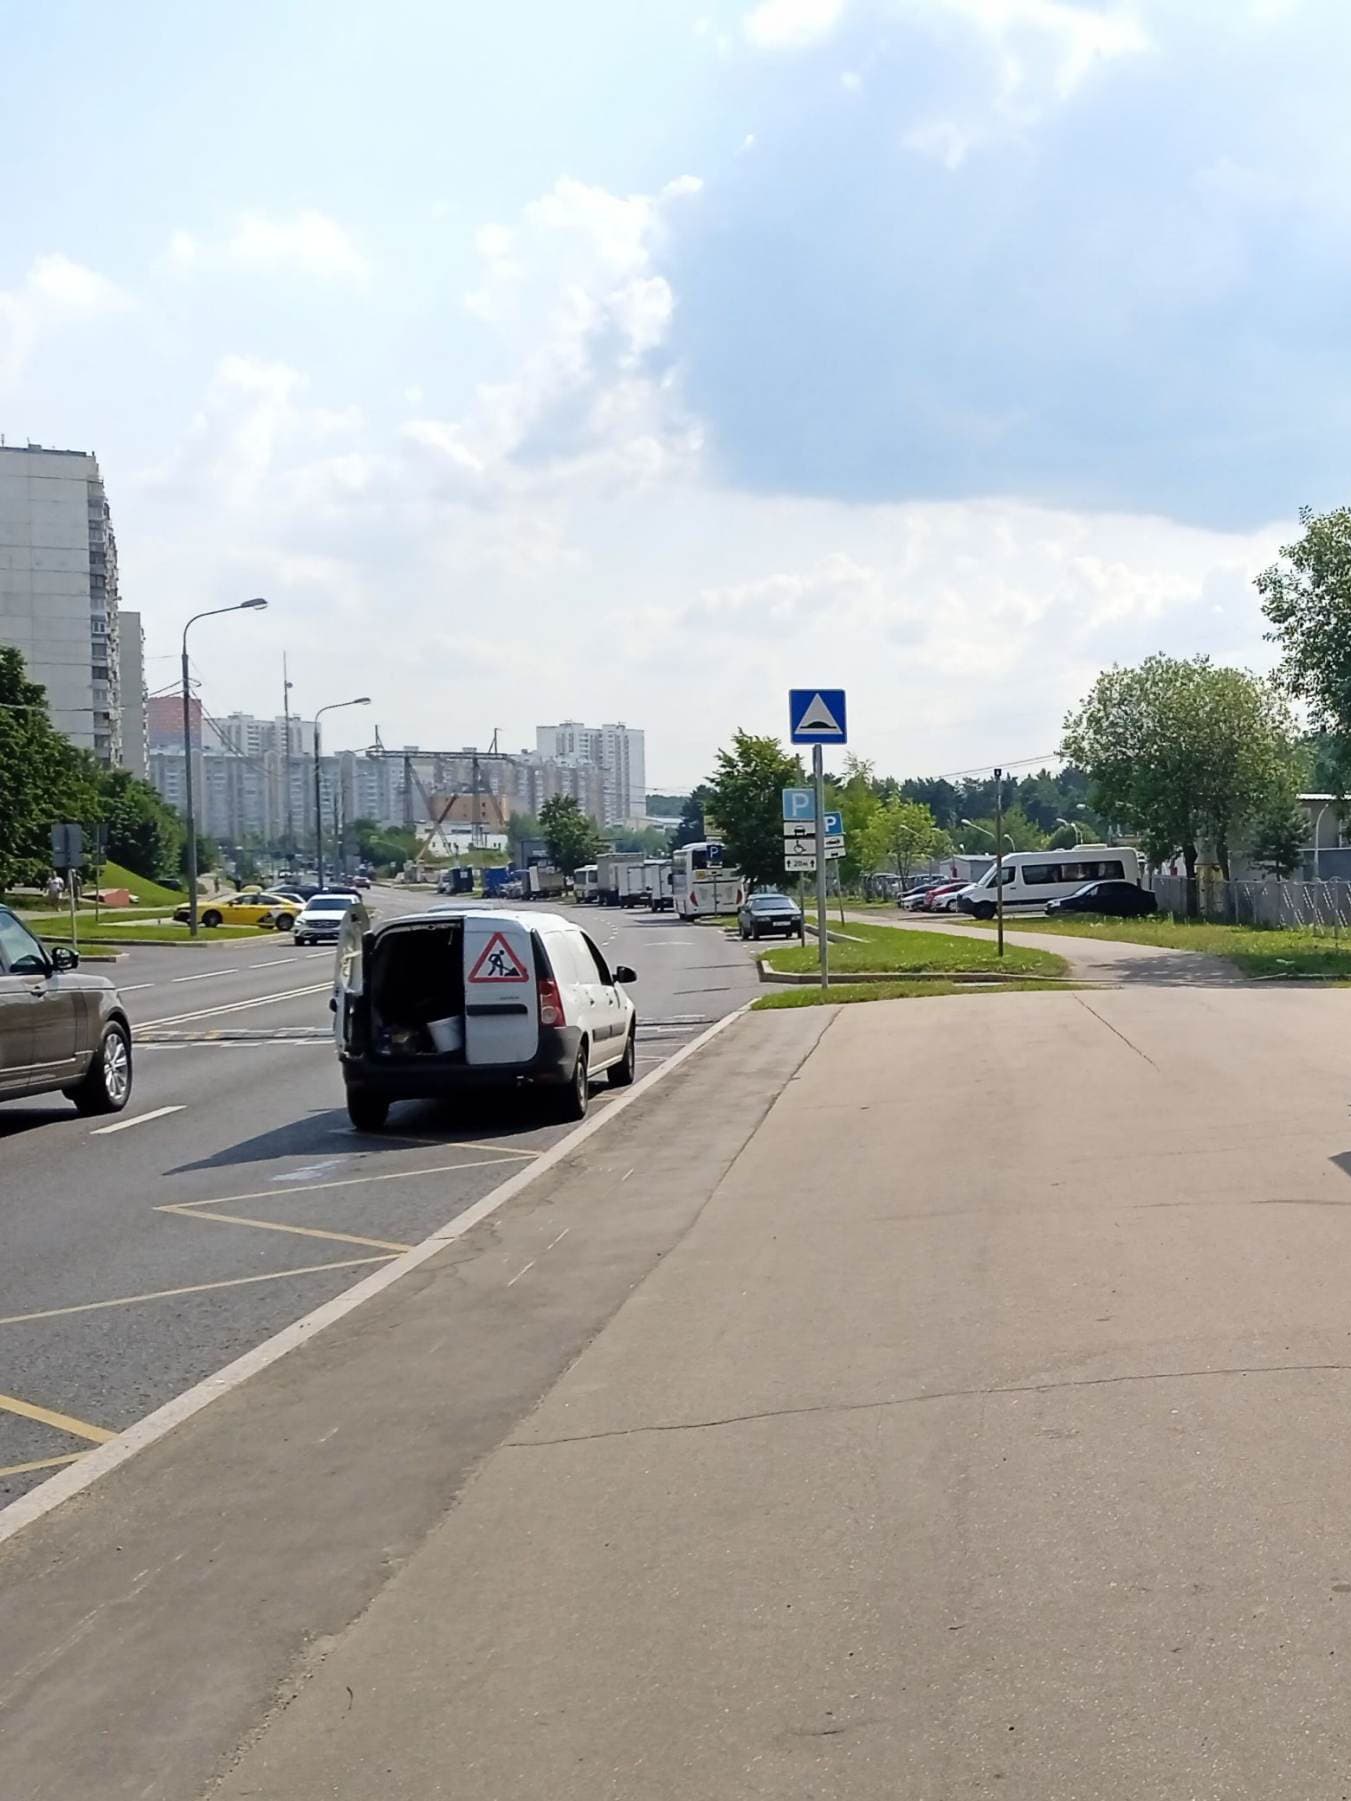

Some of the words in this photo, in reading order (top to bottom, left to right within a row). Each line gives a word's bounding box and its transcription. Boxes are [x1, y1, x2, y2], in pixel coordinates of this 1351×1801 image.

[792, 793, 809, 816] P
[824, 816, 836, 832] P
[710, 846, 719, 858] P
